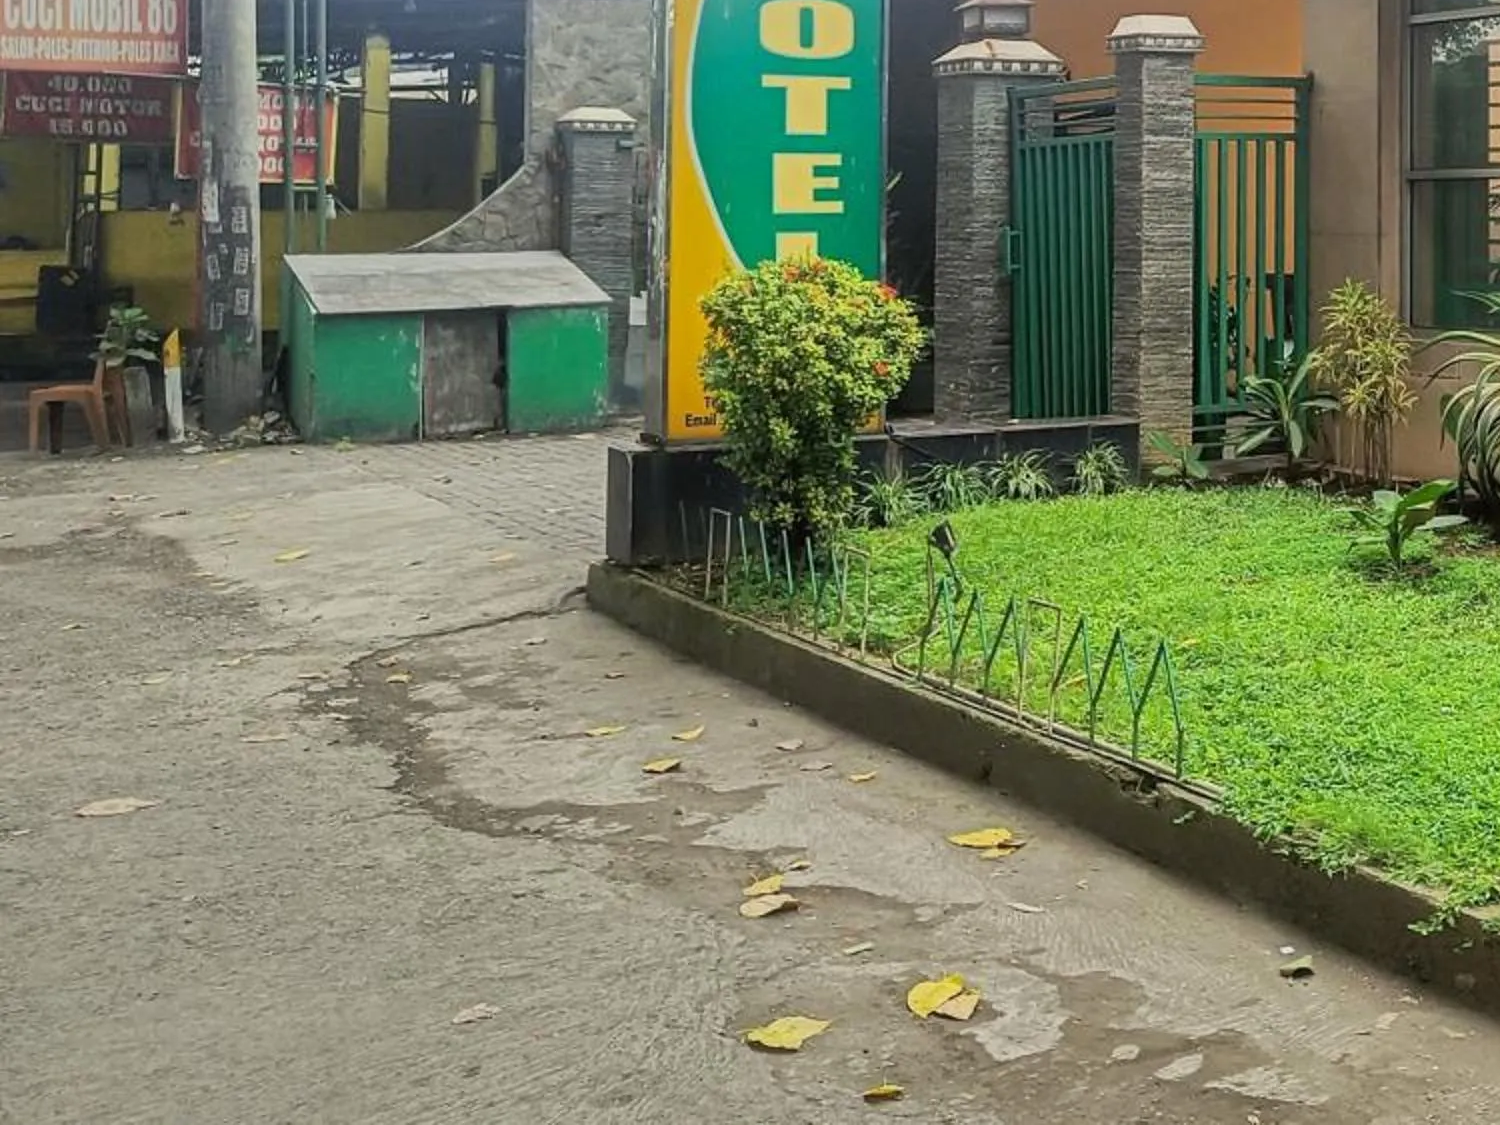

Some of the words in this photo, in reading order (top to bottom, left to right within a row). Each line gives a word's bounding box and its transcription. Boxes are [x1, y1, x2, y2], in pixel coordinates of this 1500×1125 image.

[15, 95, 71, 113] CUCI
[80, 98, 163, 117] MOTOR
[684, 412, 717, 428] Email
